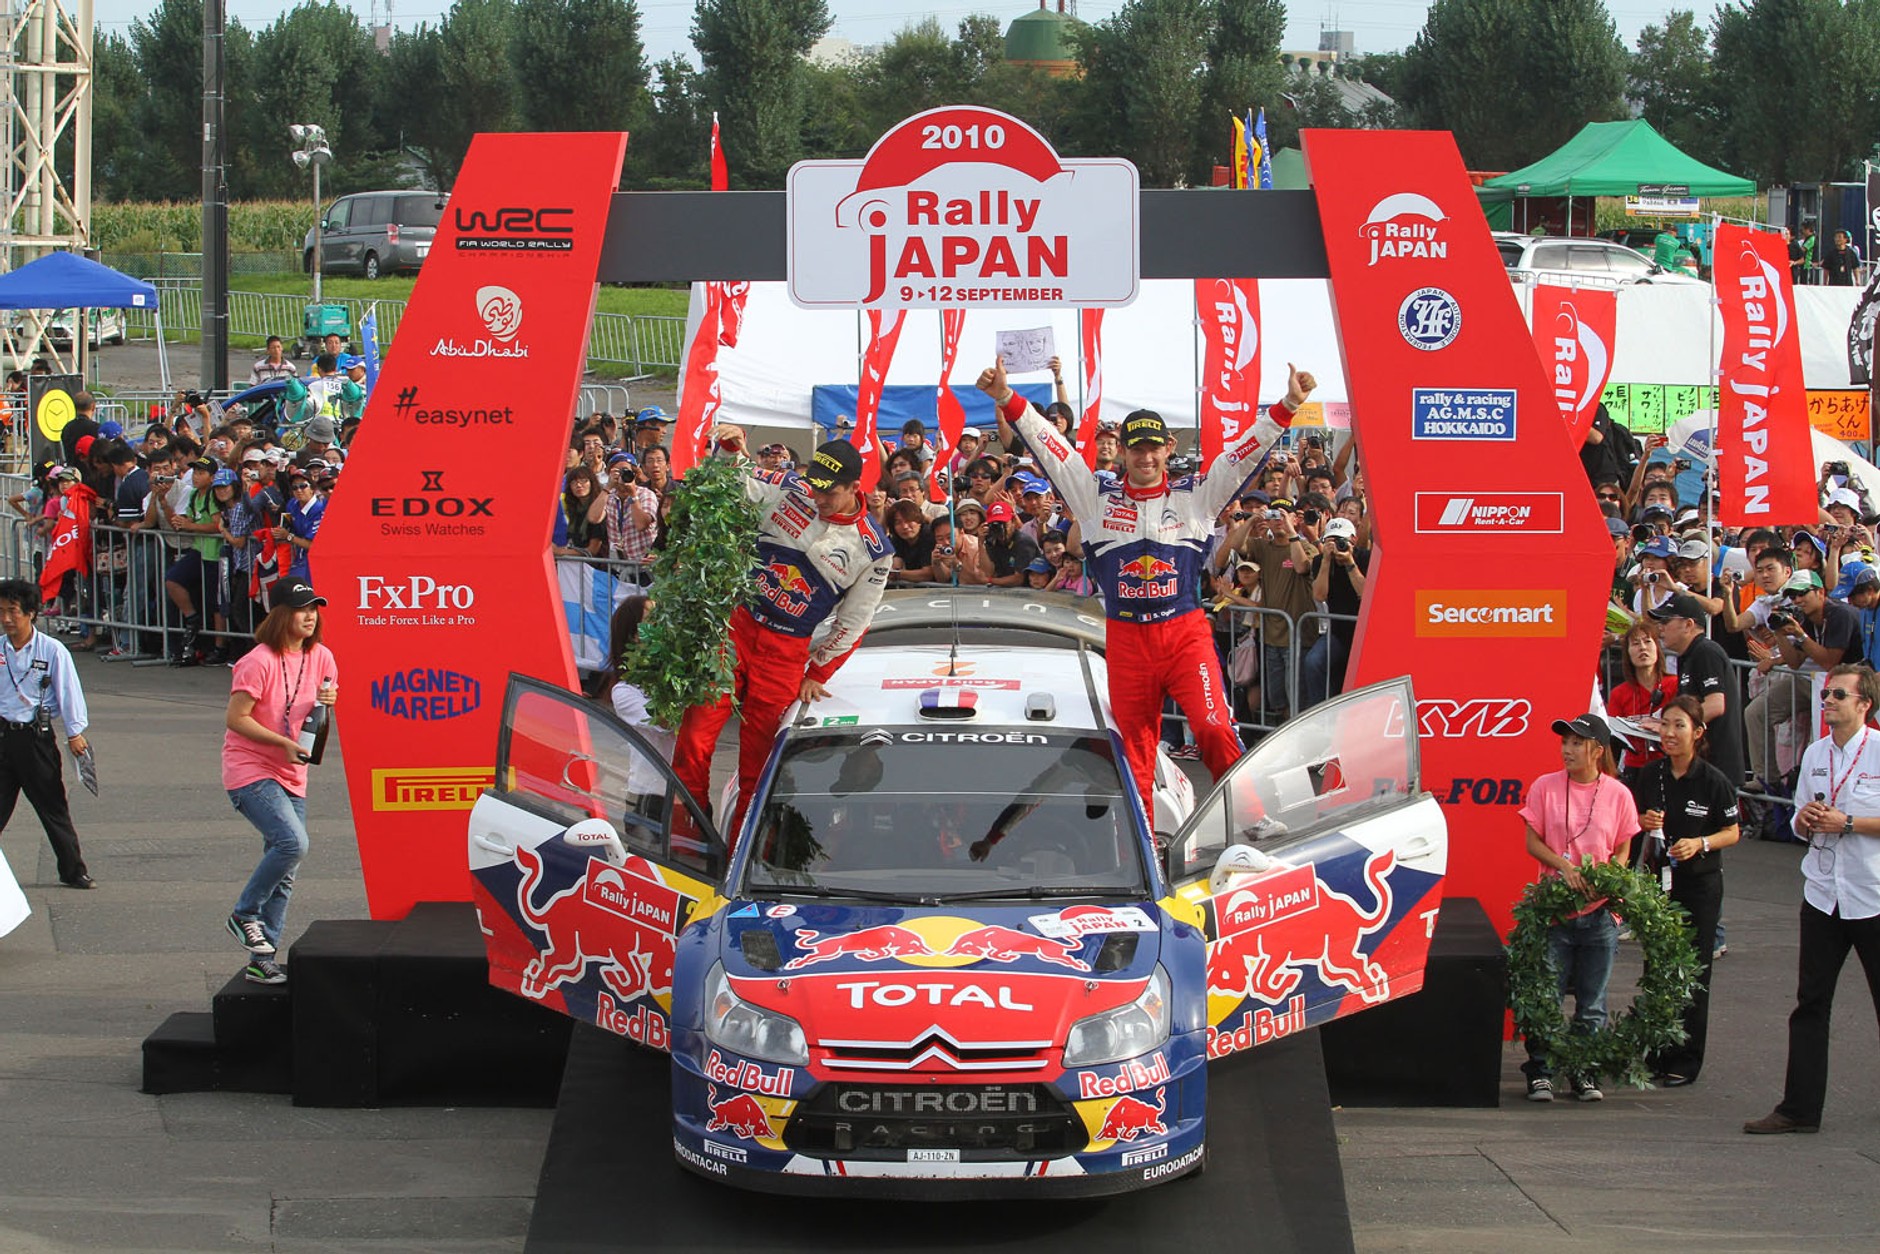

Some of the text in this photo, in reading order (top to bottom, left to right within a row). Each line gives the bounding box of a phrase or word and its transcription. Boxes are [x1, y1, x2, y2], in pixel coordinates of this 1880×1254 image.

[921, 124, 1005, 149] 2010
[456, 207, 574, 233] WRC
[907, 190, 1041, 232] Rally
[1385, 223, 1437, 241] Rally
[900, 285, 1063, 301] 9 12 SEPTEMBER
[1416, 288, 1445, 297] JAPAN
[1739, 275, 1773, 372] Rally
[1554, 336, 1577, 418] Rall
[1419, 393, 1512, 408] rally & racing
[1809, 393, 1869, 414] からあげ
[1126, 418, 1161, 432] PIRELLI
[1423, 422, 1507, 435] HOKKAIDO
[1837, 414, 1861, 429] くん
[371, 498, 494, 517] EDOX
[1114, 510, 1136, 519] TOTAL
[1471, 506, 1531, 518] NIPPON
[381, 523, 485, 535] Swiss Watches
[787, 508, 807, 530] TOTAL
[1103, 519, 1136, 533] PIRELLI
[356, 576, 475, 610] FxPro
[1117, 578, 1178, 598] Red Bull
[775, 591, 809, 618] Bull
[1428, 603, 1553, 624] Seicomart
[357, 615, 387, 625] Trade
[390, 615, 419, 625] Forex
[423, 615, 446, 625] Like
[457, 615, 475, 625] Pro
[576, 833, 611, 841] TOTAL
[600, 885, 630, 909] Rally
[771, 905, 791, 916] E
[1077, 914, 1114, 925] Rally
[1234, 904, 1267, 924] Rally
[1133, 919, 1146, 928] 2
[836, 981, 1033, 1012] TOTAL
[596, 990, 647, 1043] Red
[1205, 994, 1306, 1059] Red Bull
[704, 1048, 794, 1097] Red Bull
[1078, 1051, 1172, 1100] Red Bull
[703, 1138, 748, 1163] PIRELLI
[1121, 1142, 1168, 1167] PIRELLI
